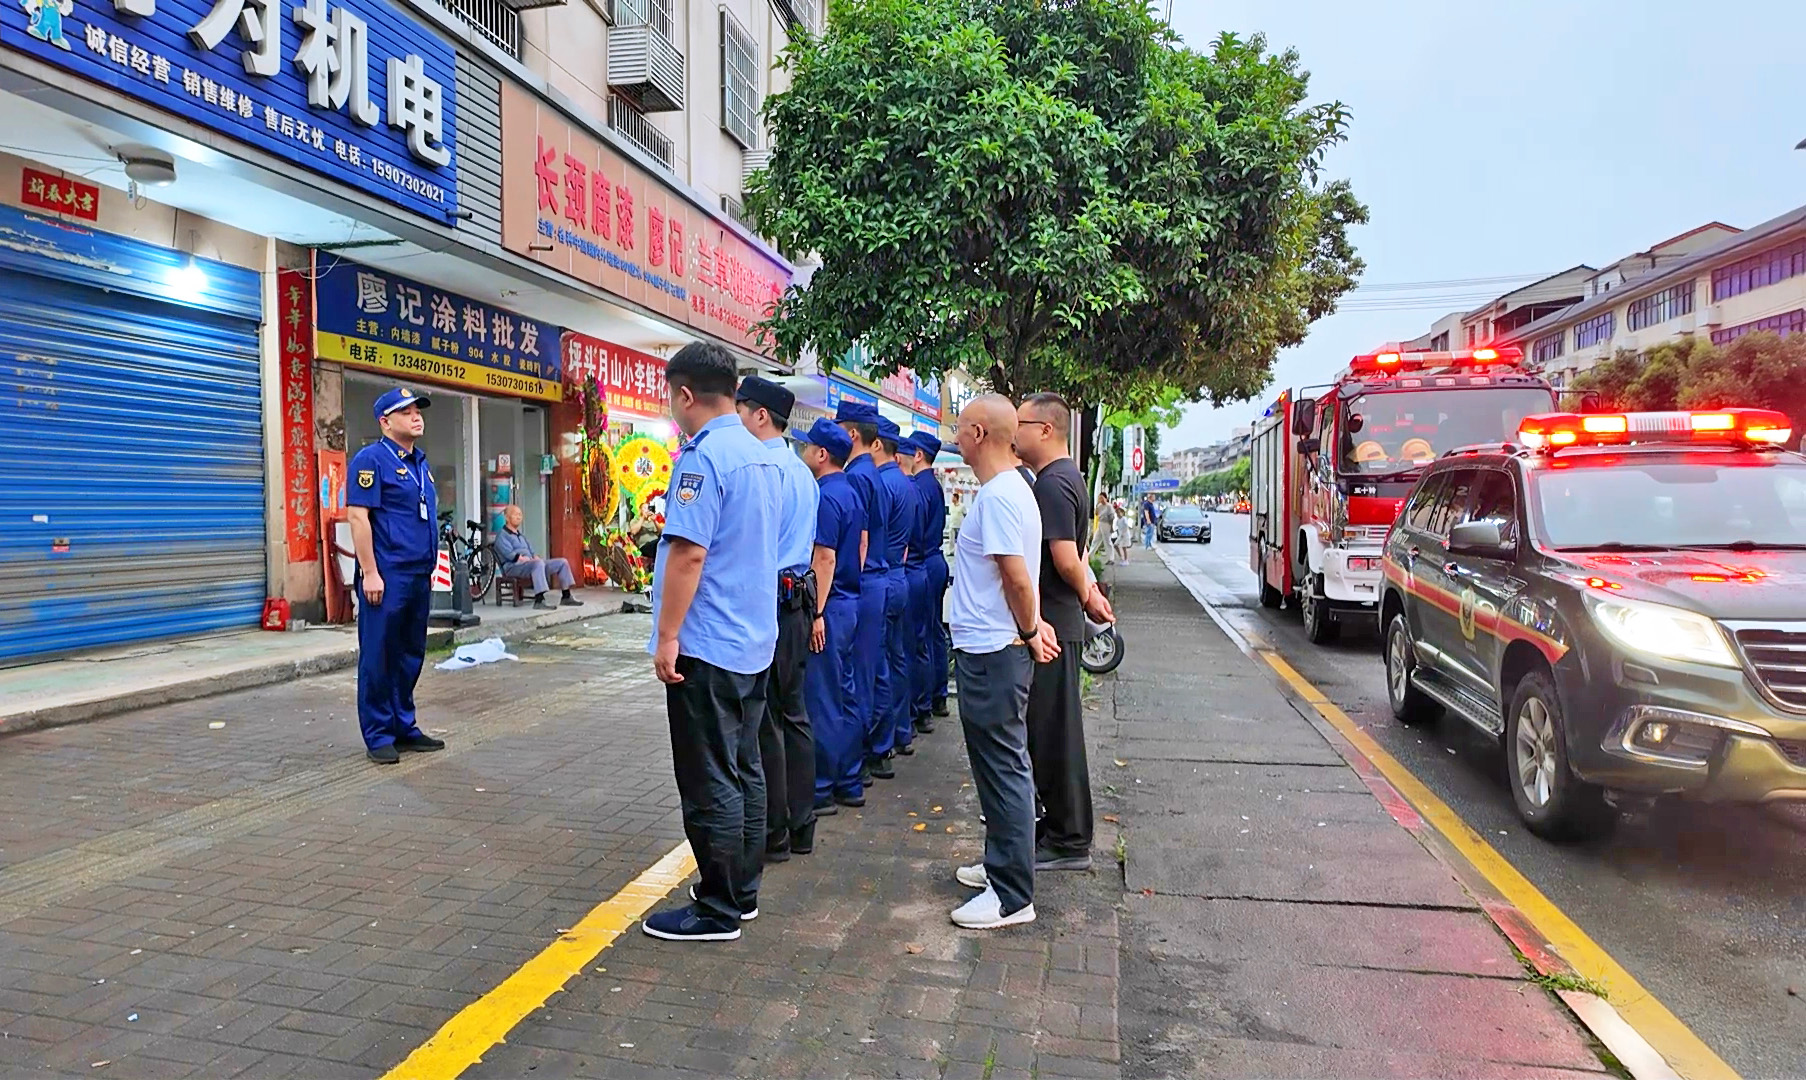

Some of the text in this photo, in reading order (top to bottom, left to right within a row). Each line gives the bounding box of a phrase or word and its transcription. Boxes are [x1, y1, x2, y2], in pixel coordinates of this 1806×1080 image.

[84, 23, 171, 84] 诚信经营
[182, 68, 254, 119] 销售维修
[264, 106, 326, 152] 售后无忧
[112, 0, 451, 168] 为机电
[28, 177, 94, 212] 新春大吉
[534, 134, 636, 252] 长颈鹿漆
[648, 206, 686, 279] 廖记
[356, 271, 540, 357] 廖记涂料批发
[468, 346, 484, 360] 904
[568, 339, 671, 400] 坪头月山小李鲜花
